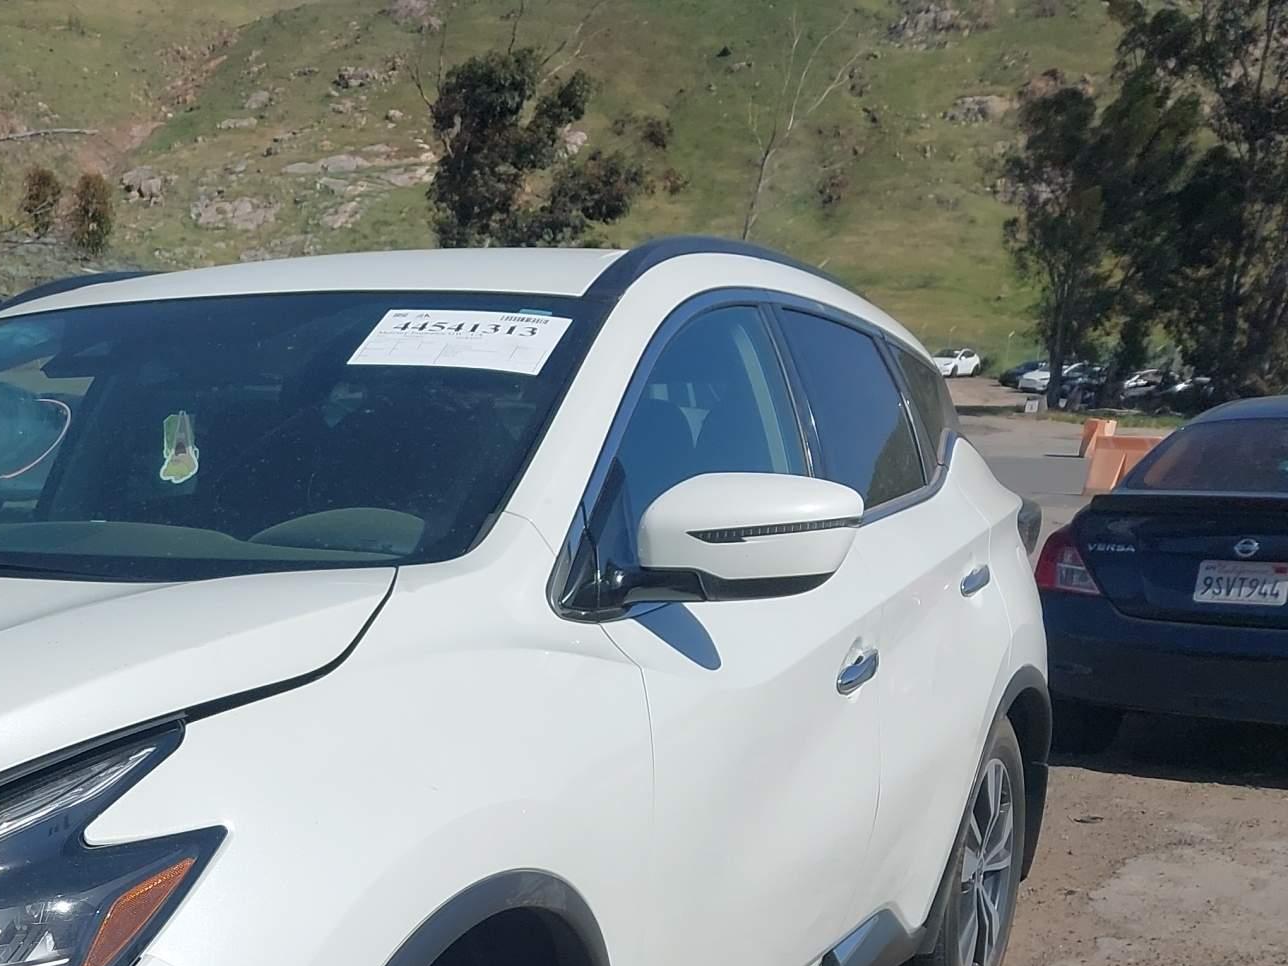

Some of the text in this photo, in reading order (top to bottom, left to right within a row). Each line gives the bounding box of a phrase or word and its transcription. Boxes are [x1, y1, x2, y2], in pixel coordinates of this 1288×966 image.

[392, 320, 538, 338] 44541313
[1087, 543, 1136, 552] VERSA
[1200, 576, 1280, 599] 9SVT944
